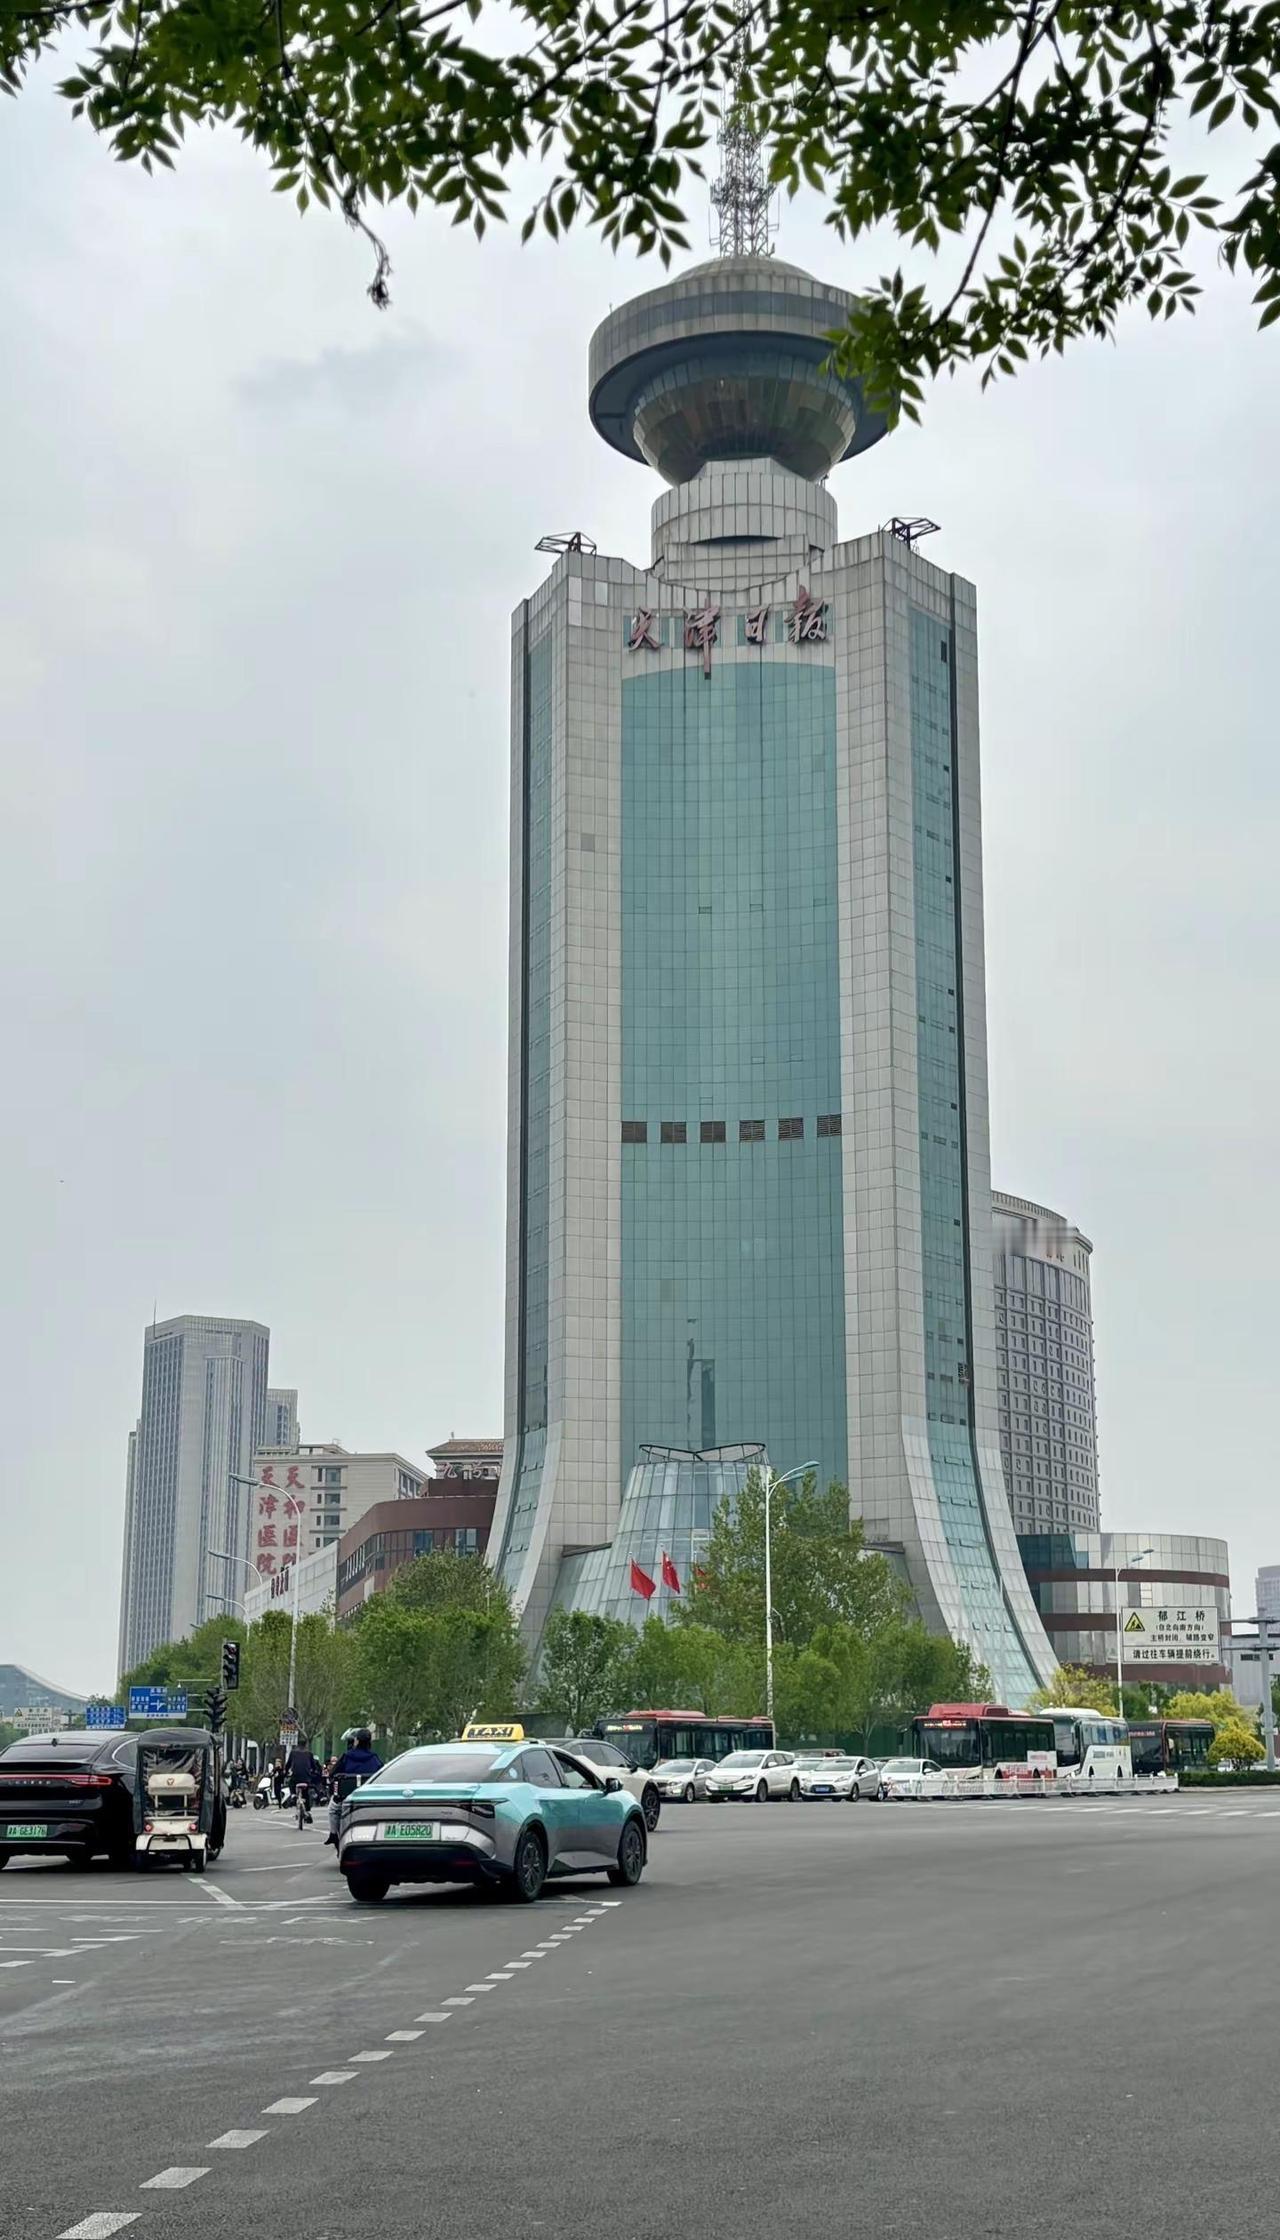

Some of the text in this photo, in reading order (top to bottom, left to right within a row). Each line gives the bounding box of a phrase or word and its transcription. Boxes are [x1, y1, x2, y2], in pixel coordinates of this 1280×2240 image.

[629, 585, 828, 677] 天津日报
[1158, 1610, 1205, 1621] 郁江桥
[473, 1727, 512, 1735] TAXI
